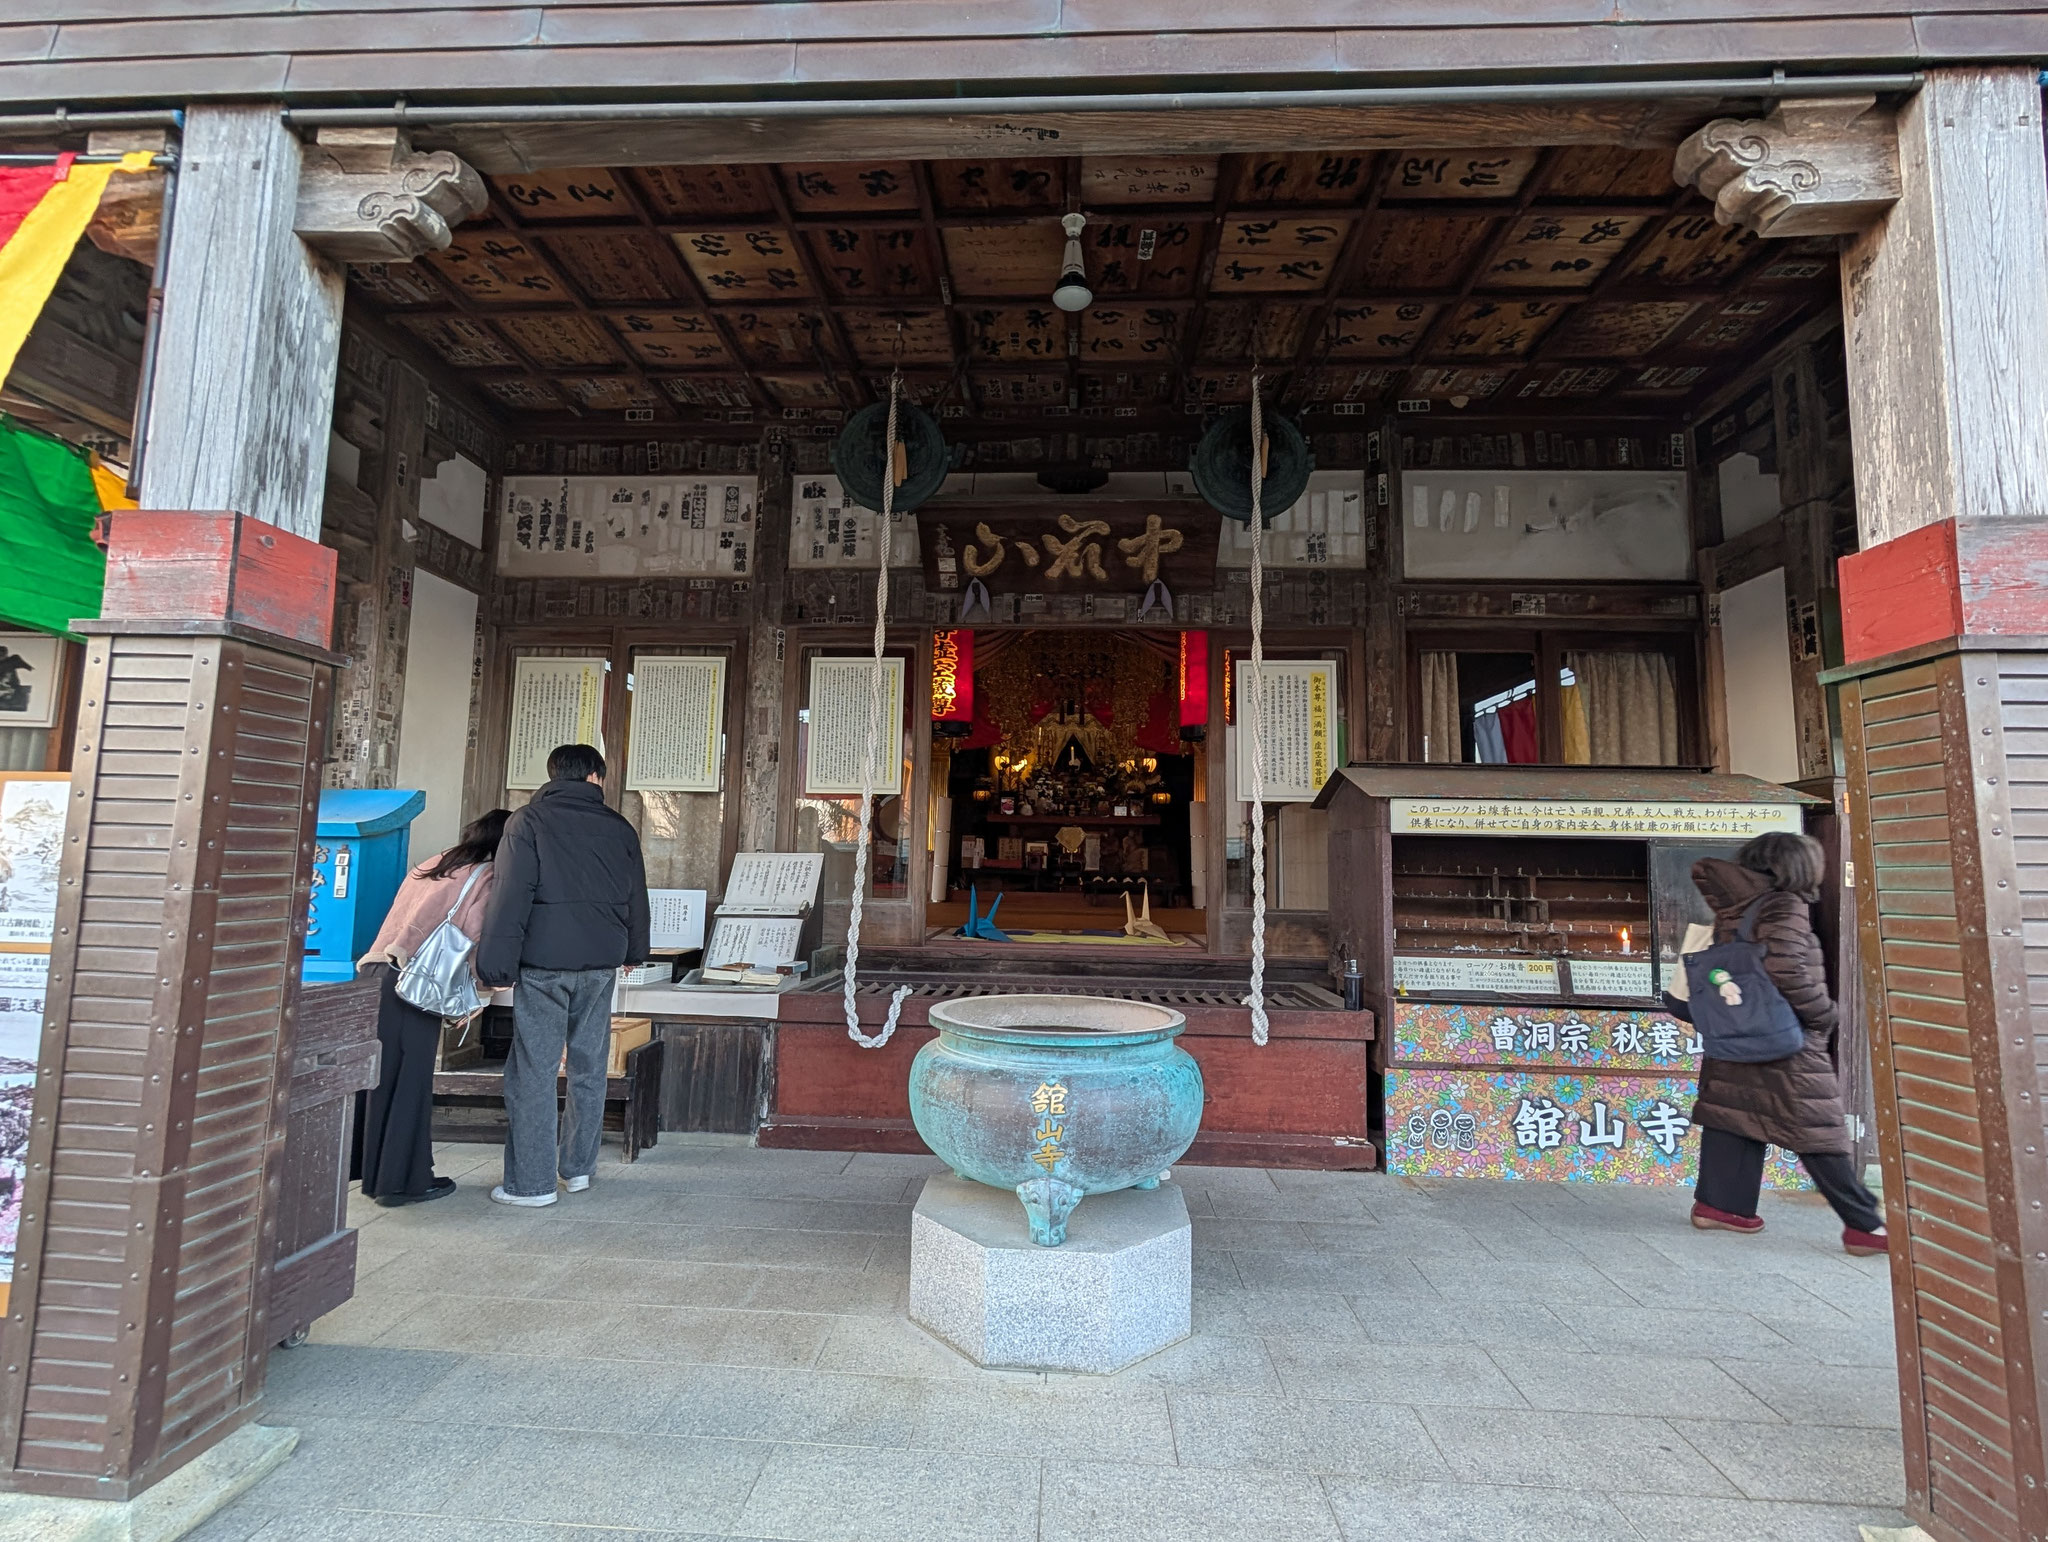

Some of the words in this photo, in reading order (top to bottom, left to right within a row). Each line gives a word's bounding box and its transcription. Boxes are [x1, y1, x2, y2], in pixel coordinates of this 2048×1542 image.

[1490, 1017, 1591, 1052] 曹洞宗
[1030, 1082, 1068, 1173] 舘山寺
[1513, 1100, 1690, 1155] 舘山寺
